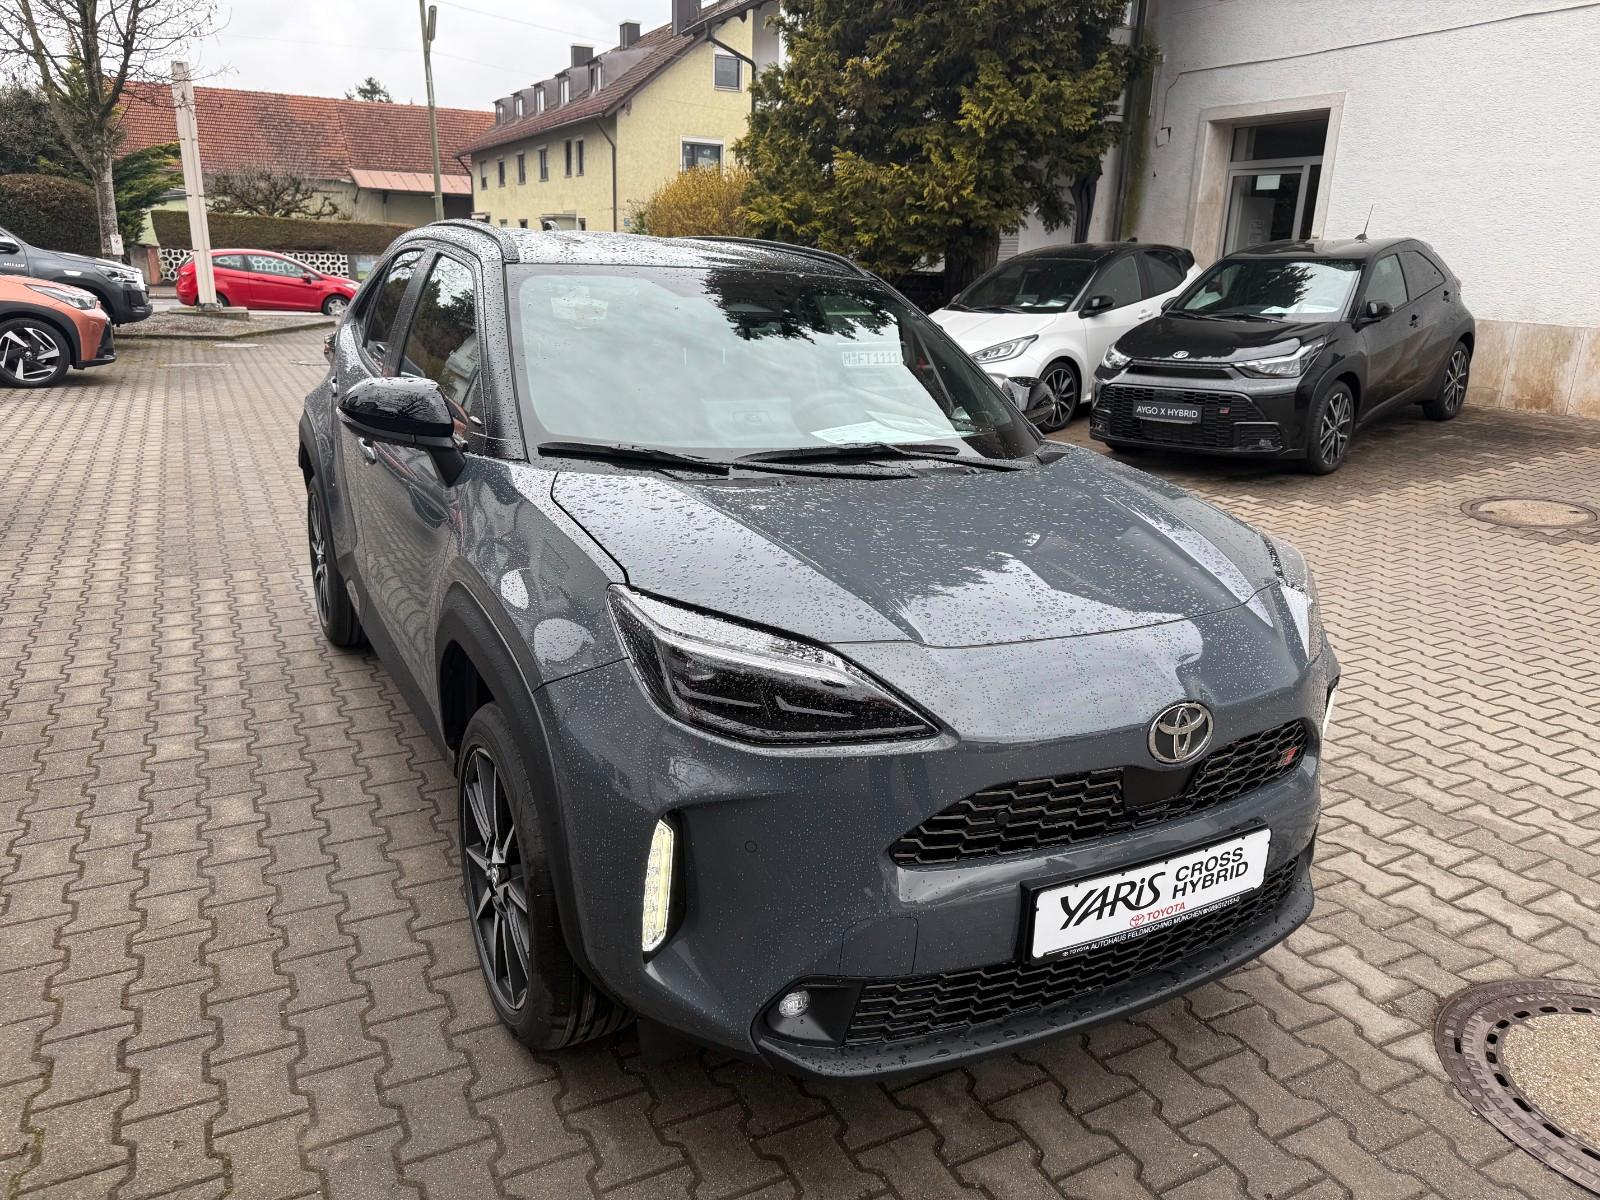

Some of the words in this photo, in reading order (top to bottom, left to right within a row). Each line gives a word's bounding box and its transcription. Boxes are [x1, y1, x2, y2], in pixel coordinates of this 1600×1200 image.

[1136, 405, 1158, 415] AYGO
[1160, 407, 1166, 415] X
[1167, 408, 1198, 418] HYBRID
[1172, 861, 1249, 900] HYBRID
[1175, 847, 1244, 883] CROSS
[1146, 901, 1186, 922] TOYOTA
[1069, 945, 1090, 954] TOYOTA
[1090, 934, 1127, 950] AUTOHAUS
[1127, 920, 1173, 939] FELDMOCHING
